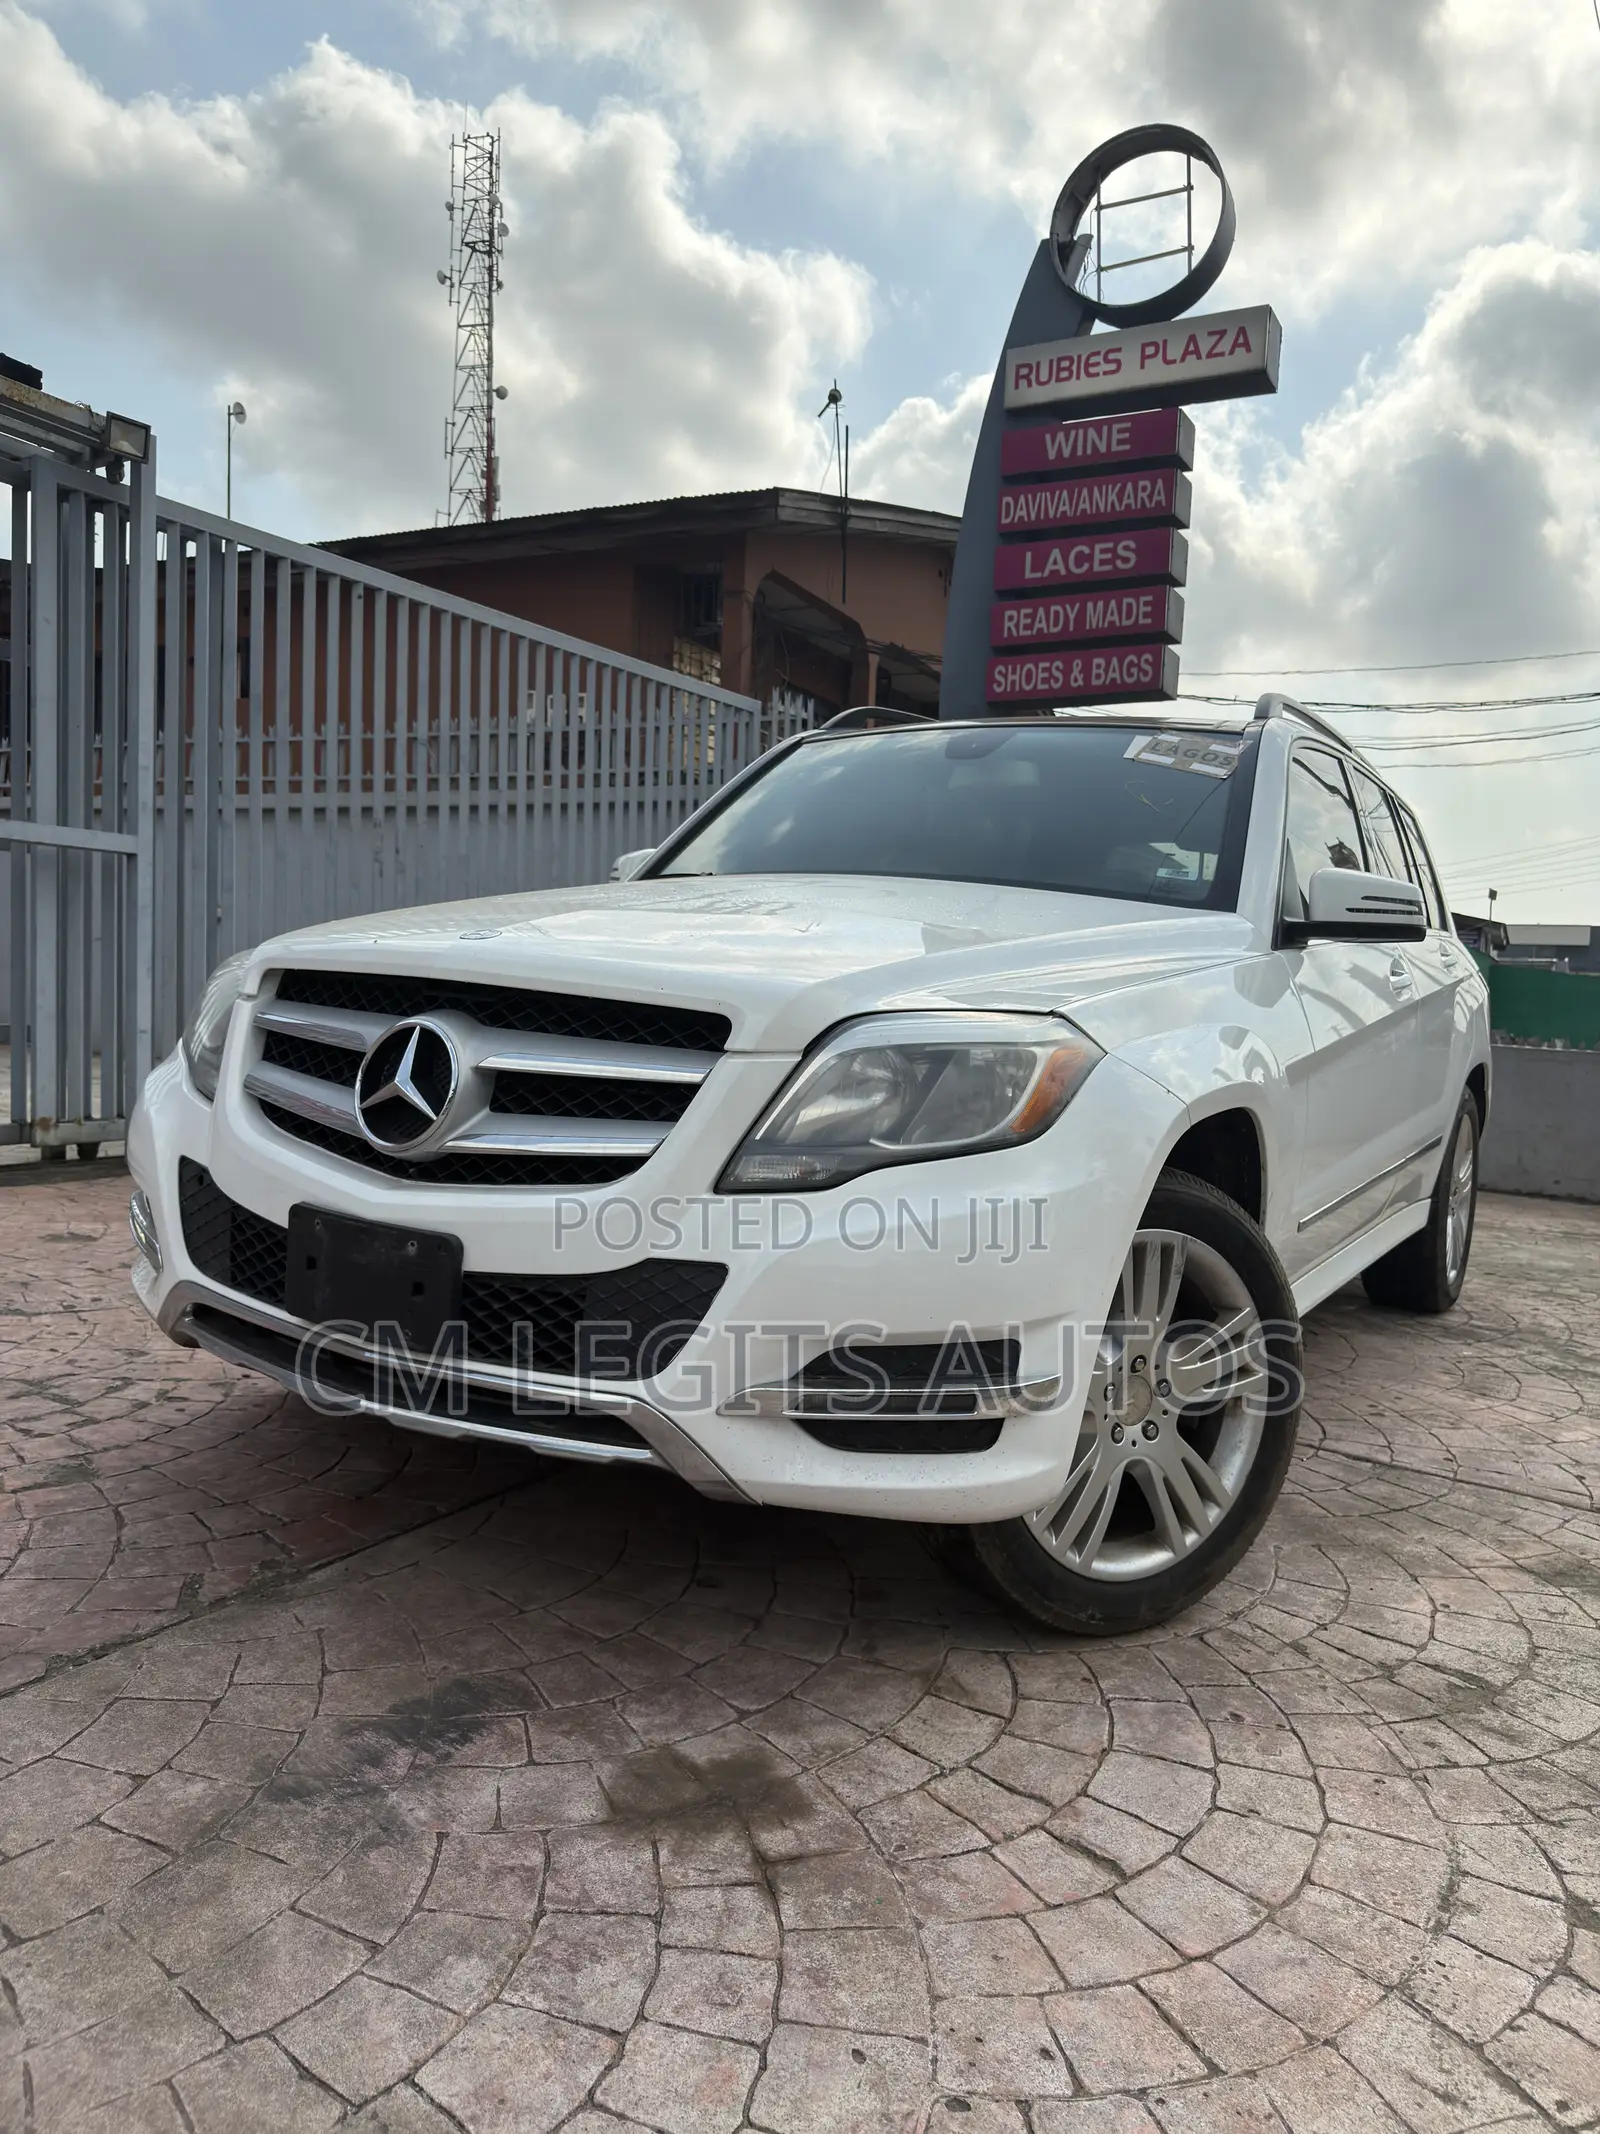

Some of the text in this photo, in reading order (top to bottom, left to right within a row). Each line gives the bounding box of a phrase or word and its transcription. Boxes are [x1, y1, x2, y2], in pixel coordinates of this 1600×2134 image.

[1013, 326, 1252, 390] RUBIES PLAZA
[1045, 422, 1131, 460] WINE
[1001, 478, 1165, 524] DAVIVA/ANKARA
[1024, 540, 1136, 579] LACES
[1003, 595, 1154, 638] READY MADE
[993, 653, 1154, 694] SHOES & BAGS
[1151, 742, 1235, 766] LAGOS
